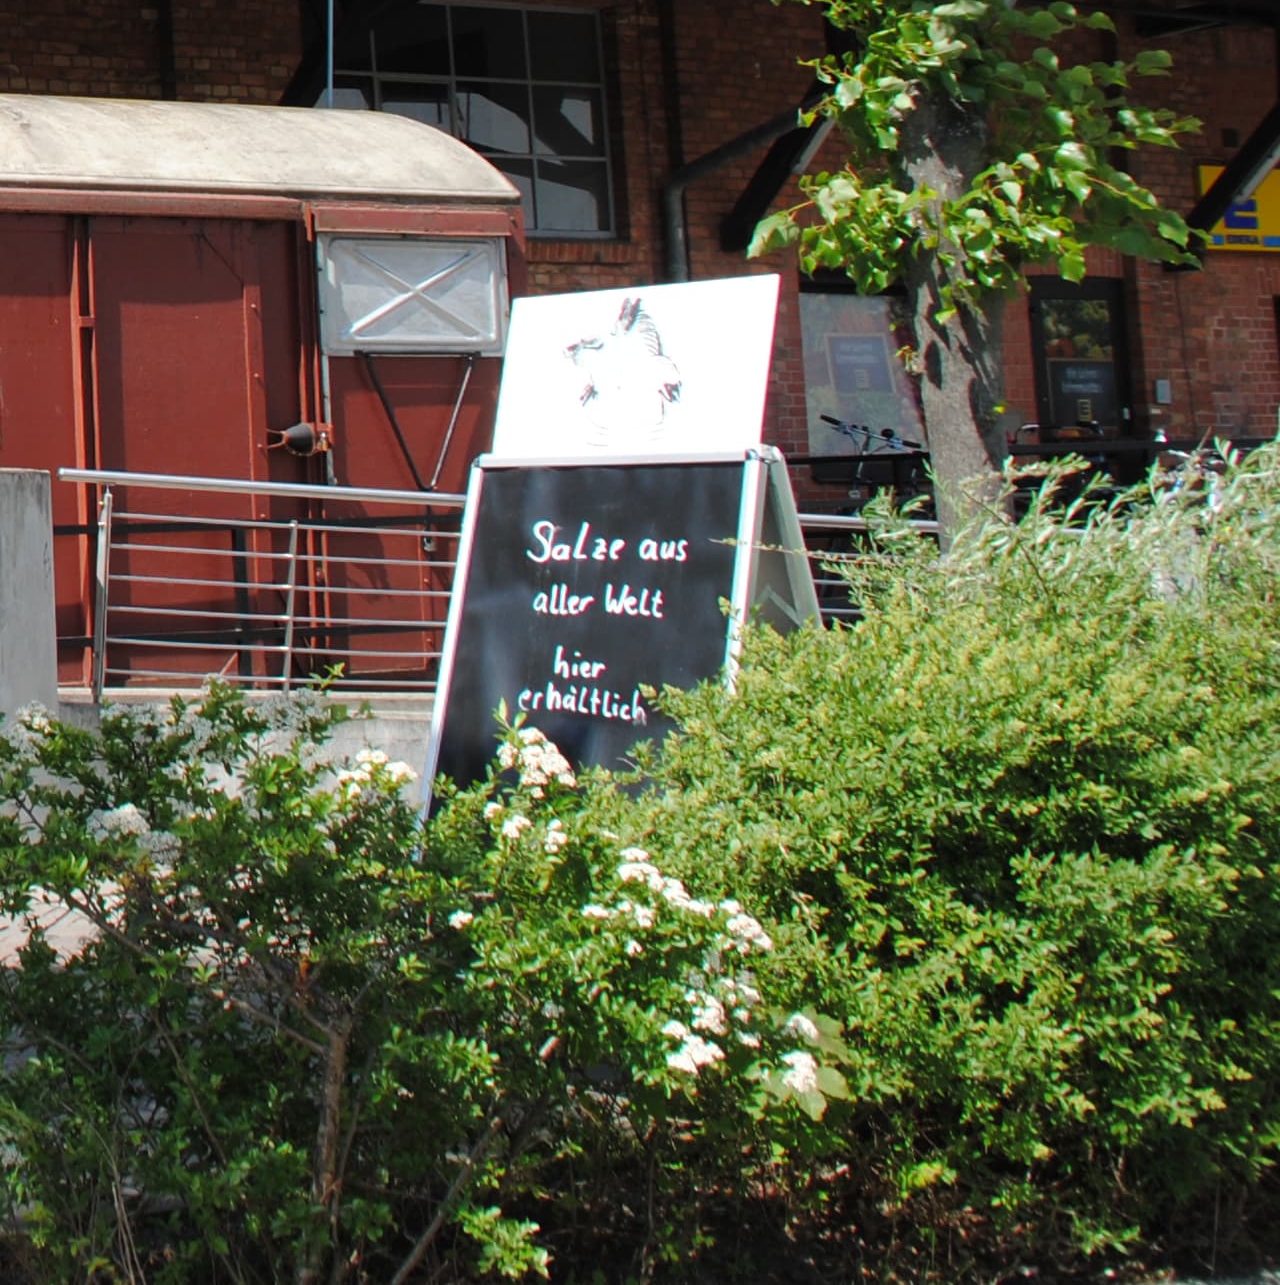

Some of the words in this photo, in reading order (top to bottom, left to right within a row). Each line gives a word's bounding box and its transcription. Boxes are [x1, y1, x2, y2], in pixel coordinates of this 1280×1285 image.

[526, 519, 626, 564] Salze
[638, 538, 689, 562] aus
[532, 582, 595, 616] aller
[604, 583, 664, 619] Welt
[553, 644, 608, 679] hier
